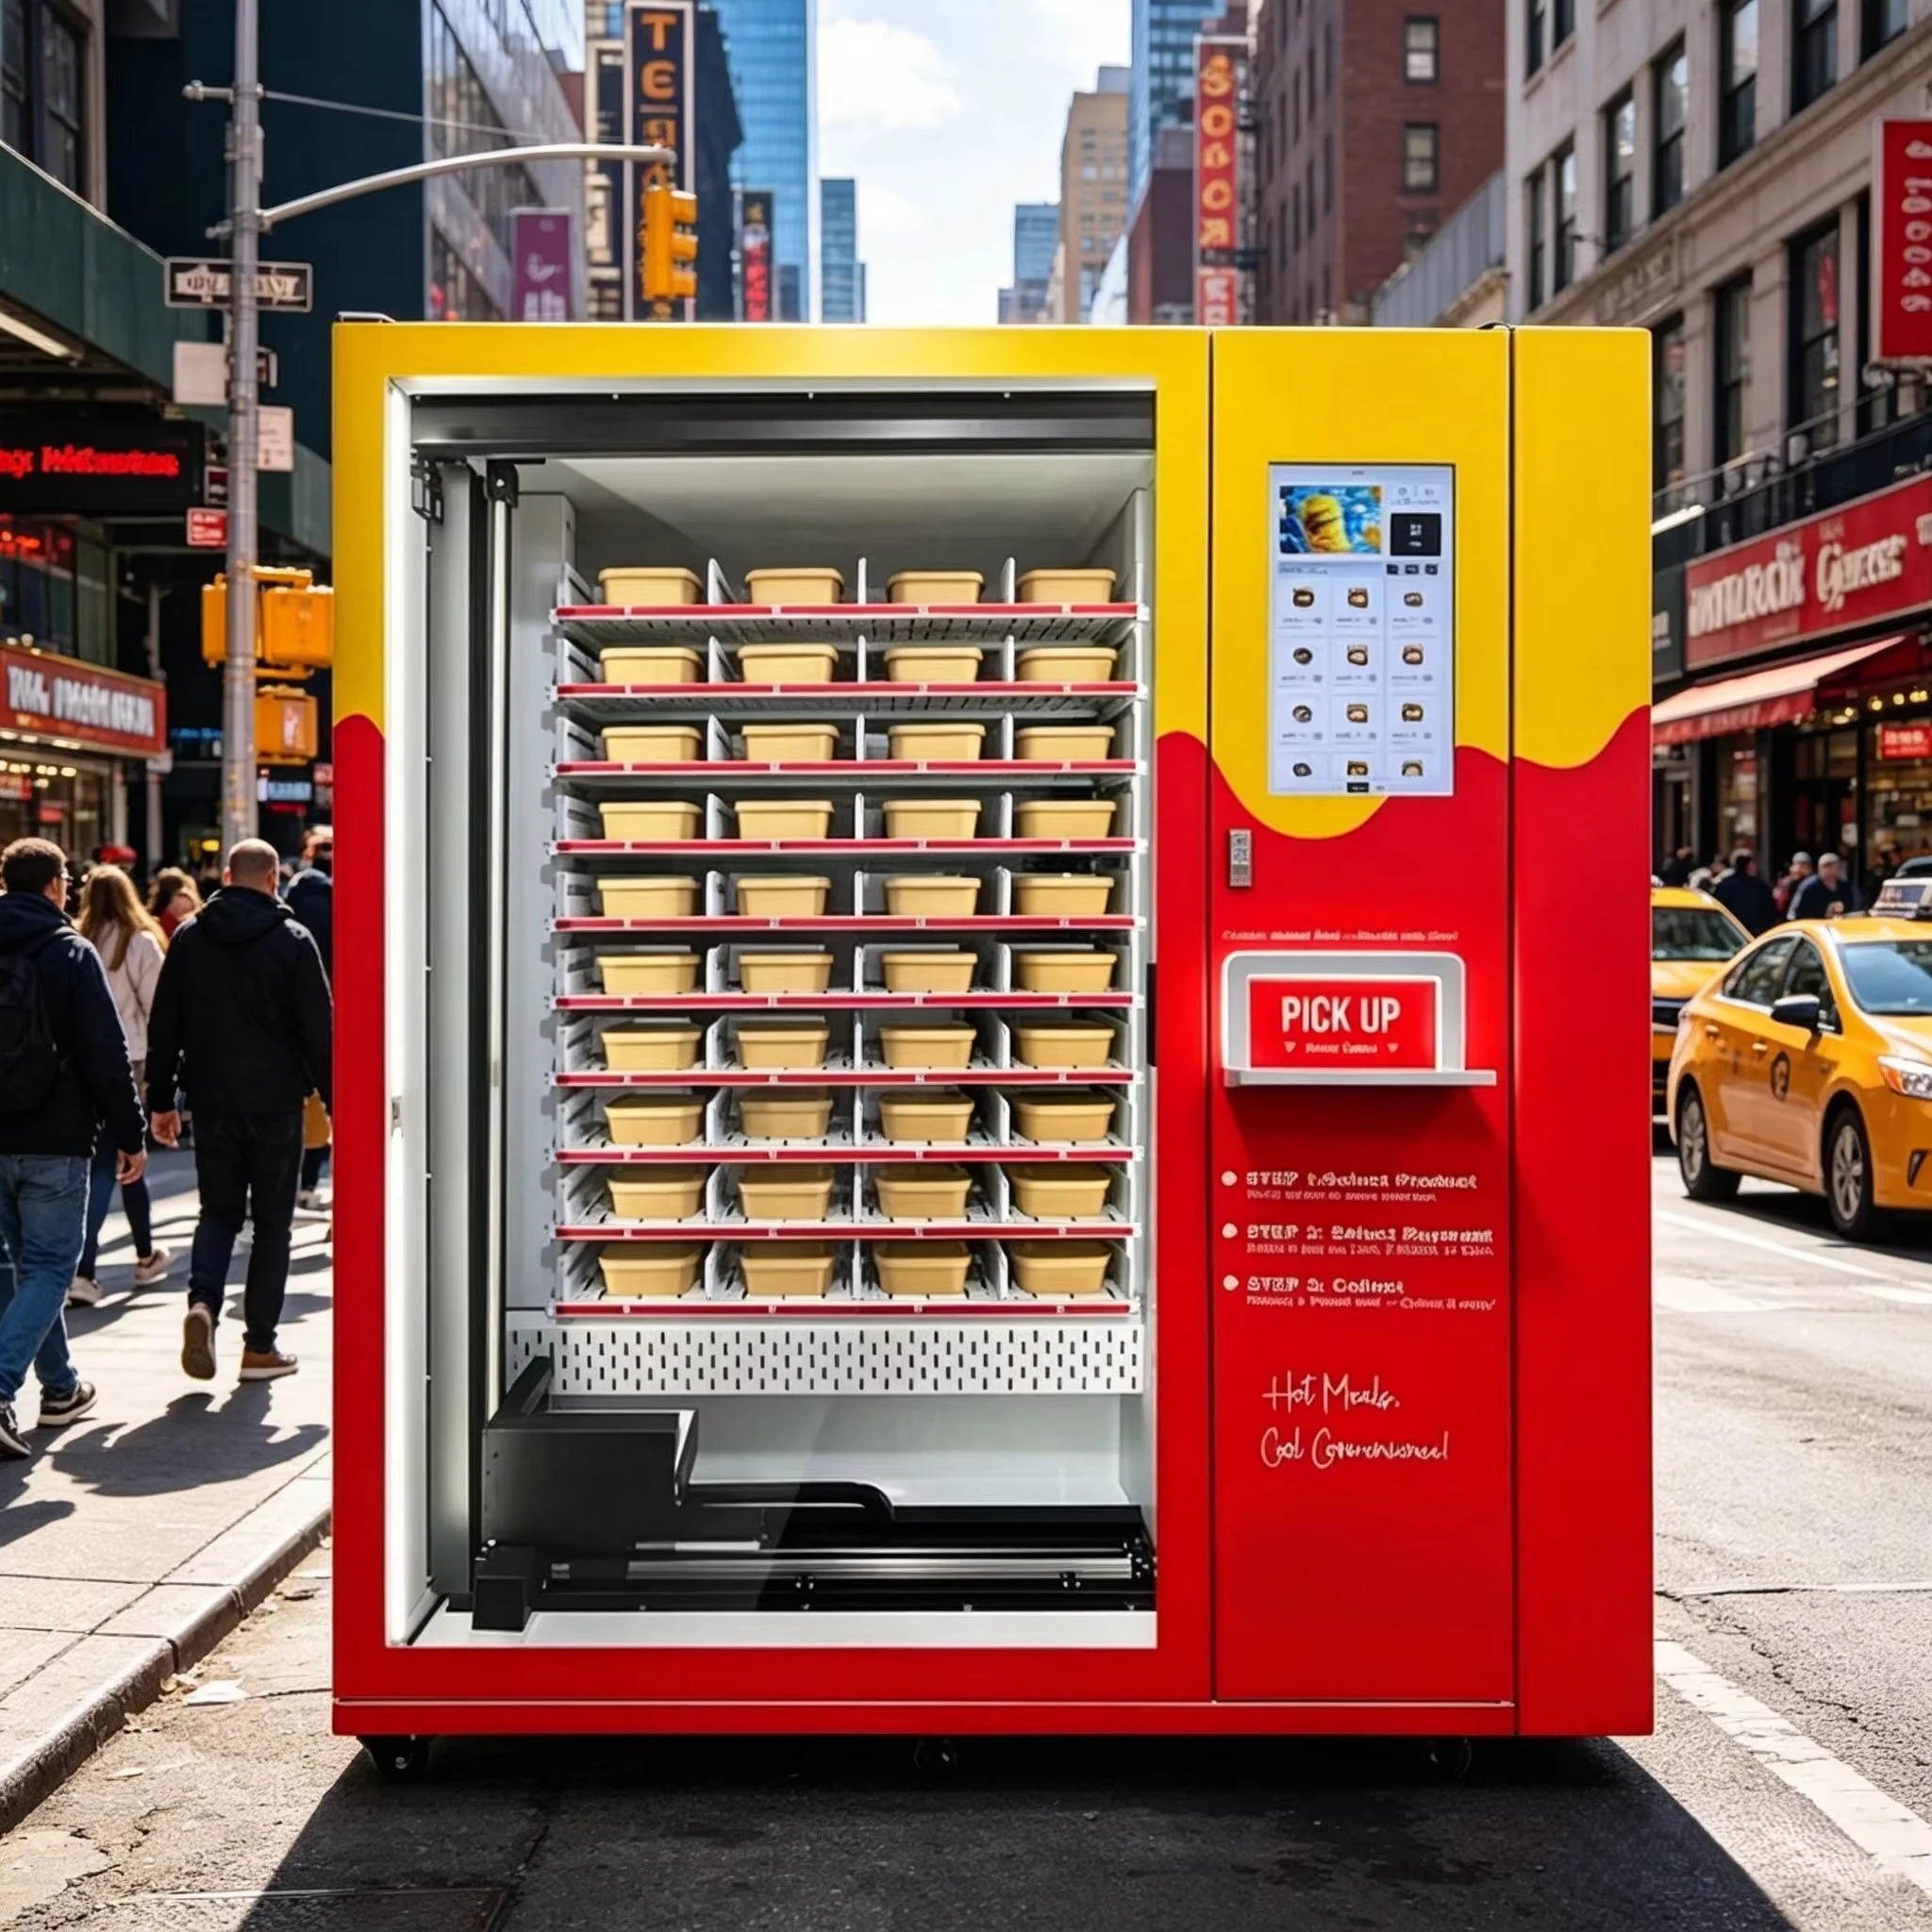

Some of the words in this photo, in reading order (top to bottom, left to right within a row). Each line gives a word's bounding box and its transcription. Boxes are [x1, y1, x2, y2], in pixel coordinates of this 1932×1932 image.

[1281, 995, 1351, 1034] PICK
[1360, 996, 1401, 1034] UP
[1261, 1370, 1317, 1413] Hot
